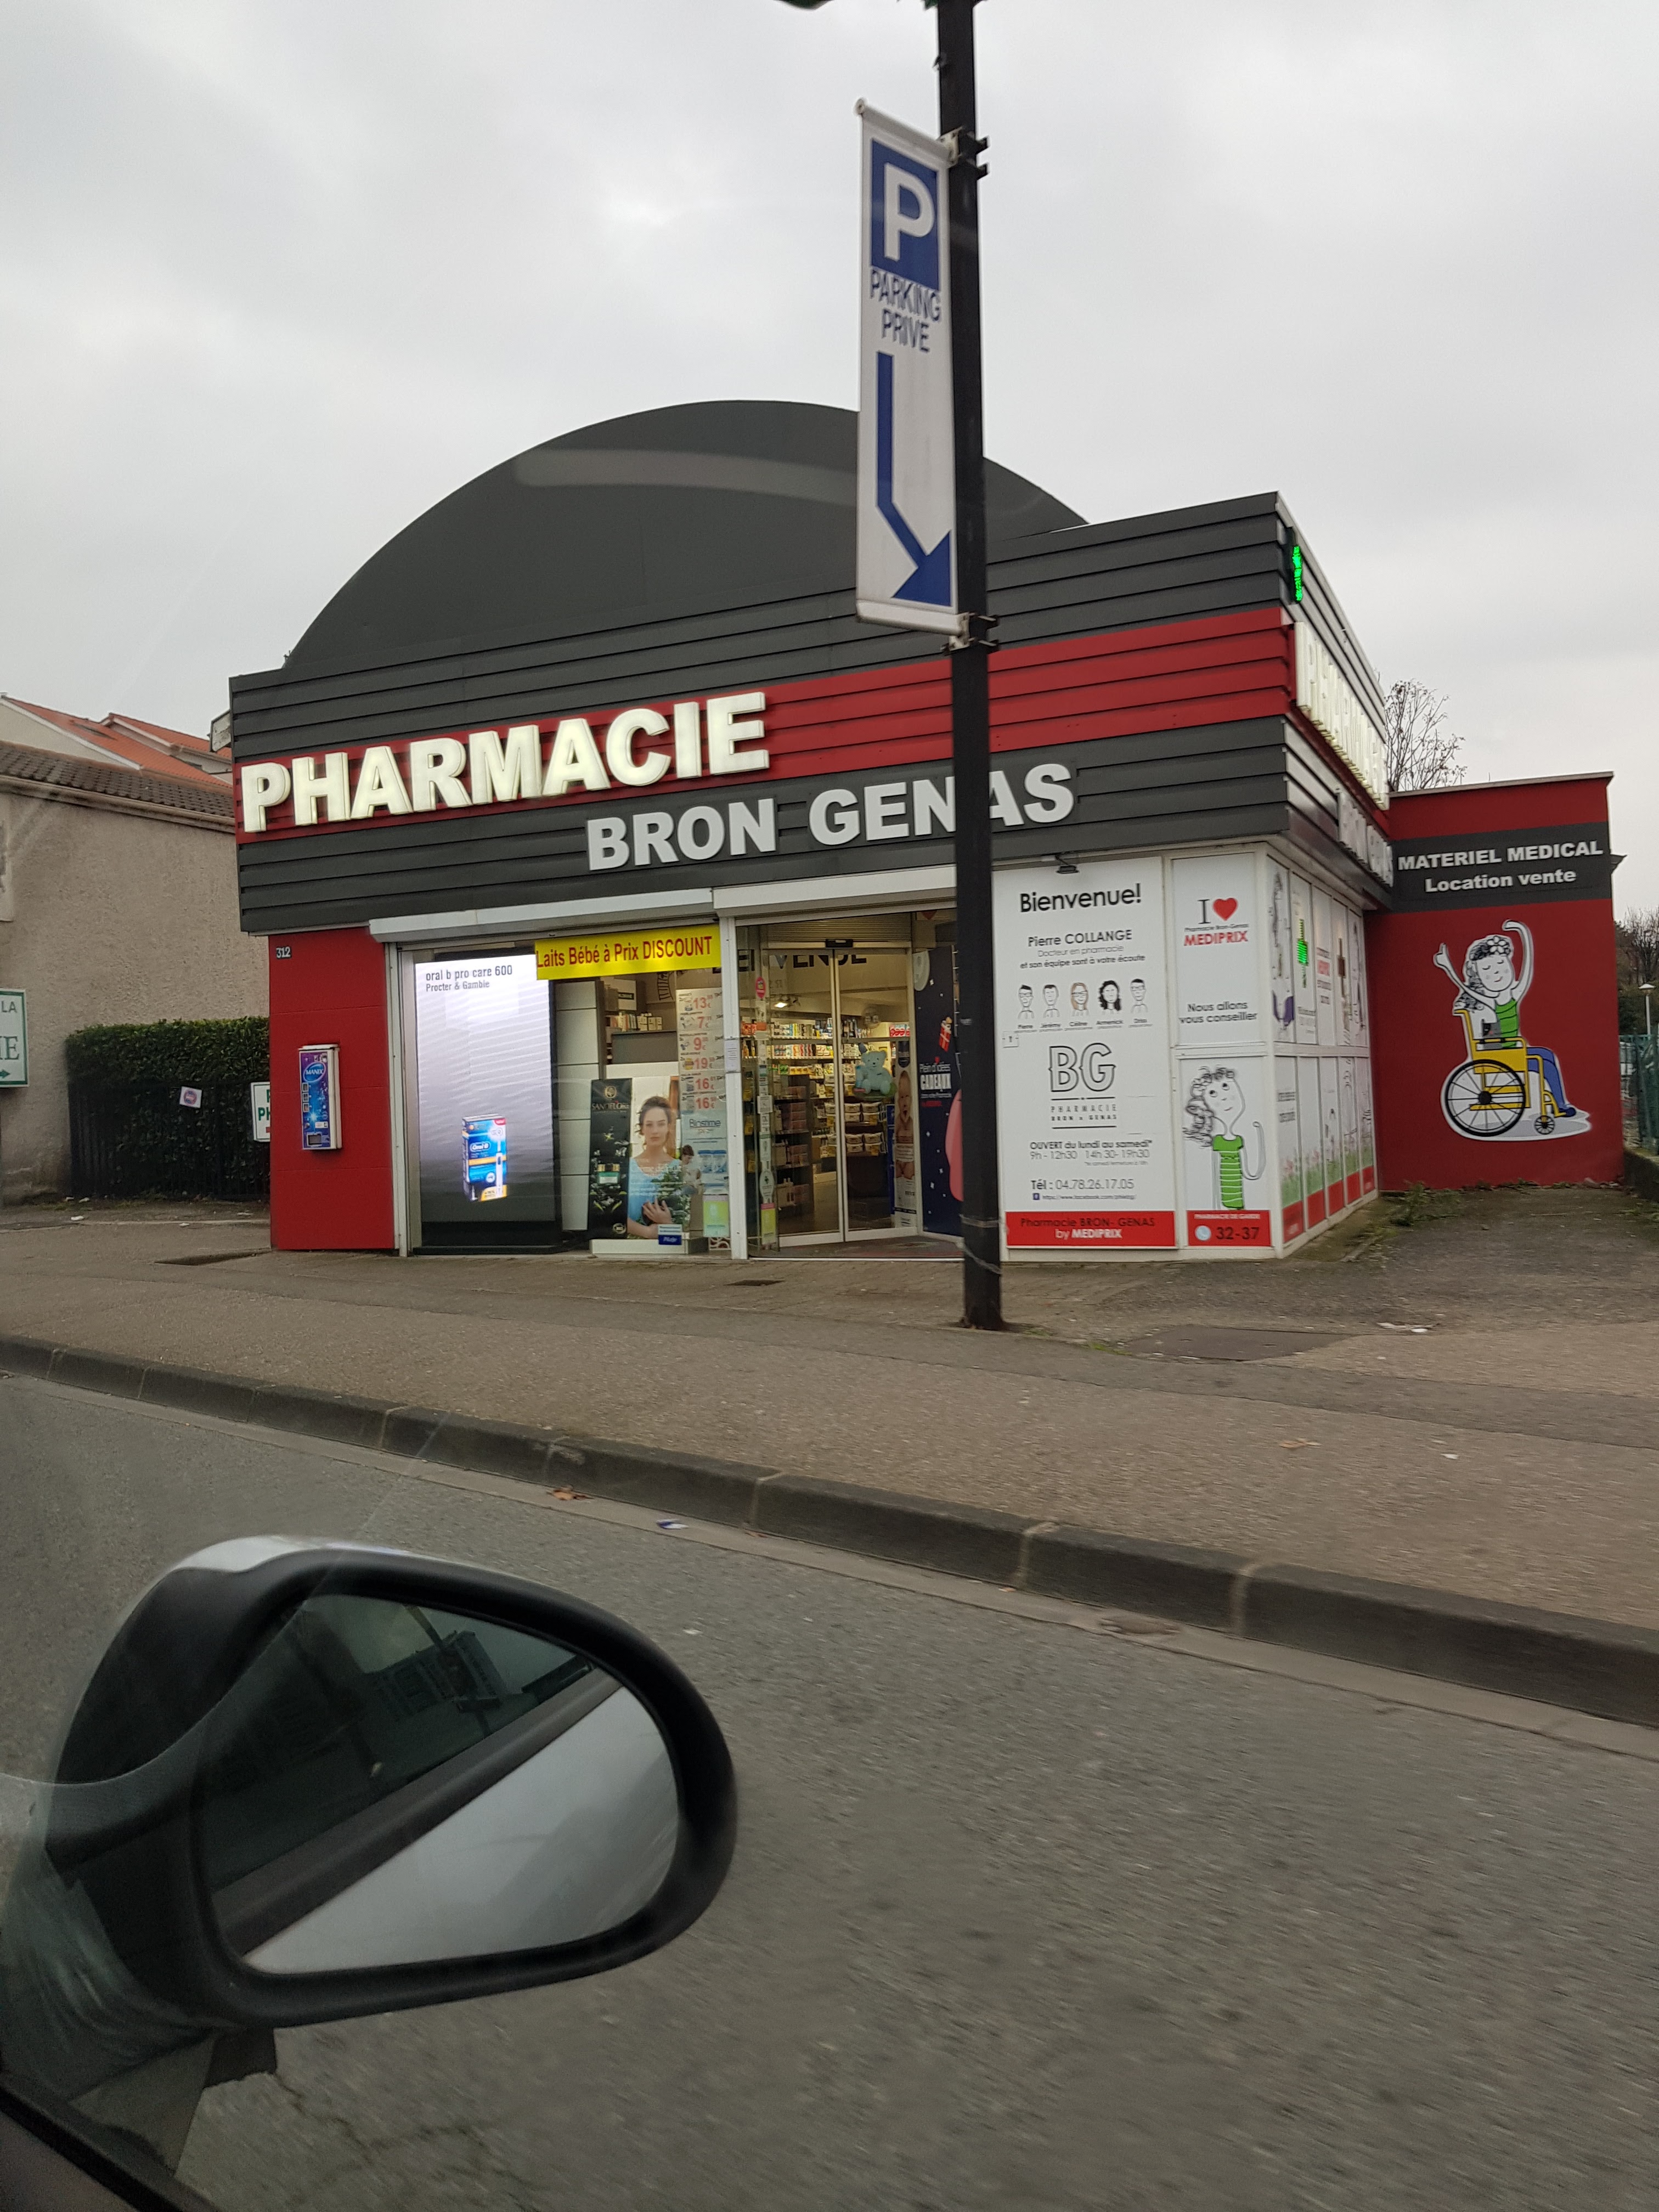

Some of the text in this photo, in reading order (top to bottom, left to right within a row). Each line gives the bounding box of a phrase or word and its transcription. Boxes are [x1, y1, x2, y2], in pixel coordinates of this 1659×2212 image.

[883, 162, 935, 262] P
[870, 267, 940, 322] PARKING
[241, 691, 770, 833] PHARMACIE
[586, 763, 1075, 871] BRON GENAS
[1398, 840, 1604, 871] MATERIEL MEDICAL
[1425, 869, 1577, 893] Location vente
[1020, 882, 1141, 913] Bienvenue!
[1197, 899, 1211, 924] I
[1028, 929, 1132, 947] Pierre COLLANGE
[1184, 930, 1249, 946] MEDIPRIX
[276, 946, 291, 959] 312
[537, 935, 712, 967] Laits Bébé à Prix DISCOUNT
[426, 964, 513, 981] oral b pro care 600
[426, 983, 452, 992] Procter
[1187, 1001, 1248, 1012] Nous allons
[1206, 1011, 1258, 1022] conseiller
[1048, 1042, 1116, 1092] BG
[1030, 1141, 1062, 1150] OUVERT
[1078, 1140, 1101, 1148] lundi
[1055, 1178, 1135, 1189] 04.78.26.17.05
[1020, 1217, 1077, 1227] Pharmacie
[1118, 1217, 1155, 1227] GENAS
[1055, 1228, 1122, 1240] by MEDIPRIX
[1216, 1226, 1260, 1240] 32-37
